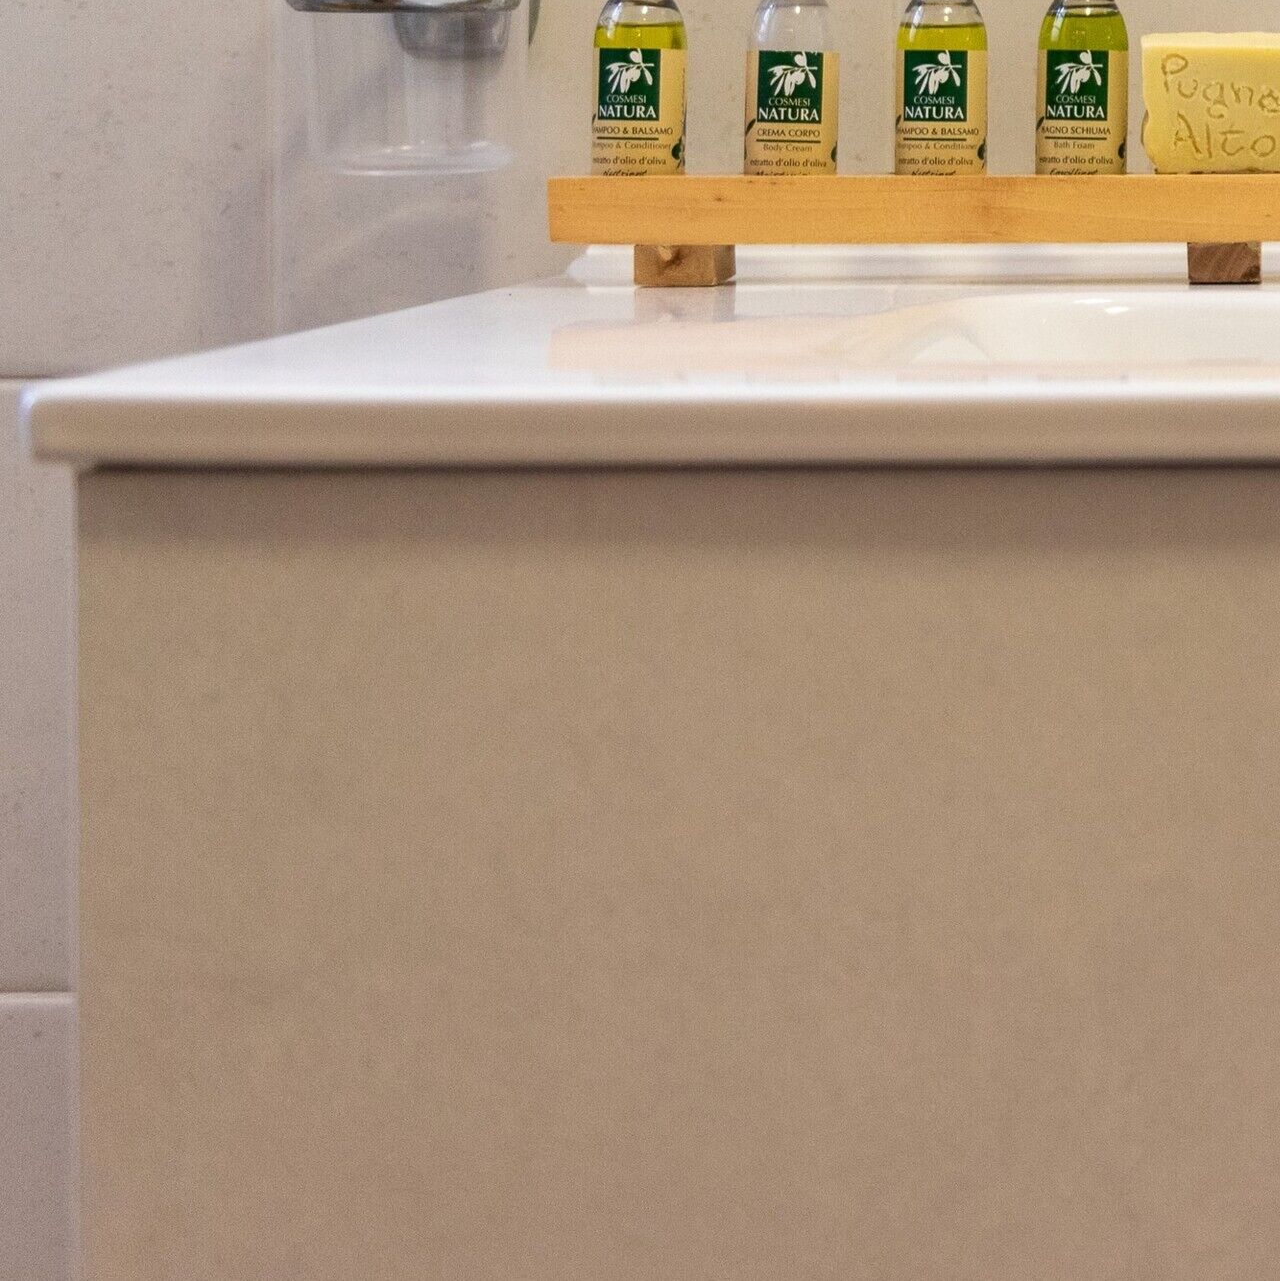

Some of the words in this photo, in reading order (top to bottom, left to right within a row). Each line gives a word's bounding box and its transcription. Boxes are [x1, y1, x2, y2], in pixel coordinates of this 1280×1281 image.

[606, 94, 647, 104] COSMESI
[768, 98, 811, 107] COSMESI
[914, 96, 955, 105] COSMESI
[1055, 94, 1096, 105] COSMESI
[599, 104, 657, 118] NATURA
[758, 107, 819, 121] NATURA
[904, 105, 964, 120] NATURA
[1046, 104, 1105, 118] NATURA
[622, 127, 629, 135] &
[632, 126, 673, 136] BALSAMO
[757, 128, 786, 137] CREMA
[788, 129, 820, 138] CORPO
[931, 128, 938, 136] &
[941, 127, 979, 136] BALSAMO
[1070, 126, 1111, 135] SCHIUMA
[1174, 110, 1276, 158] Alto
[785, 143, 813, 152] Cream
[1072, 141, 1095, 150] Foam
